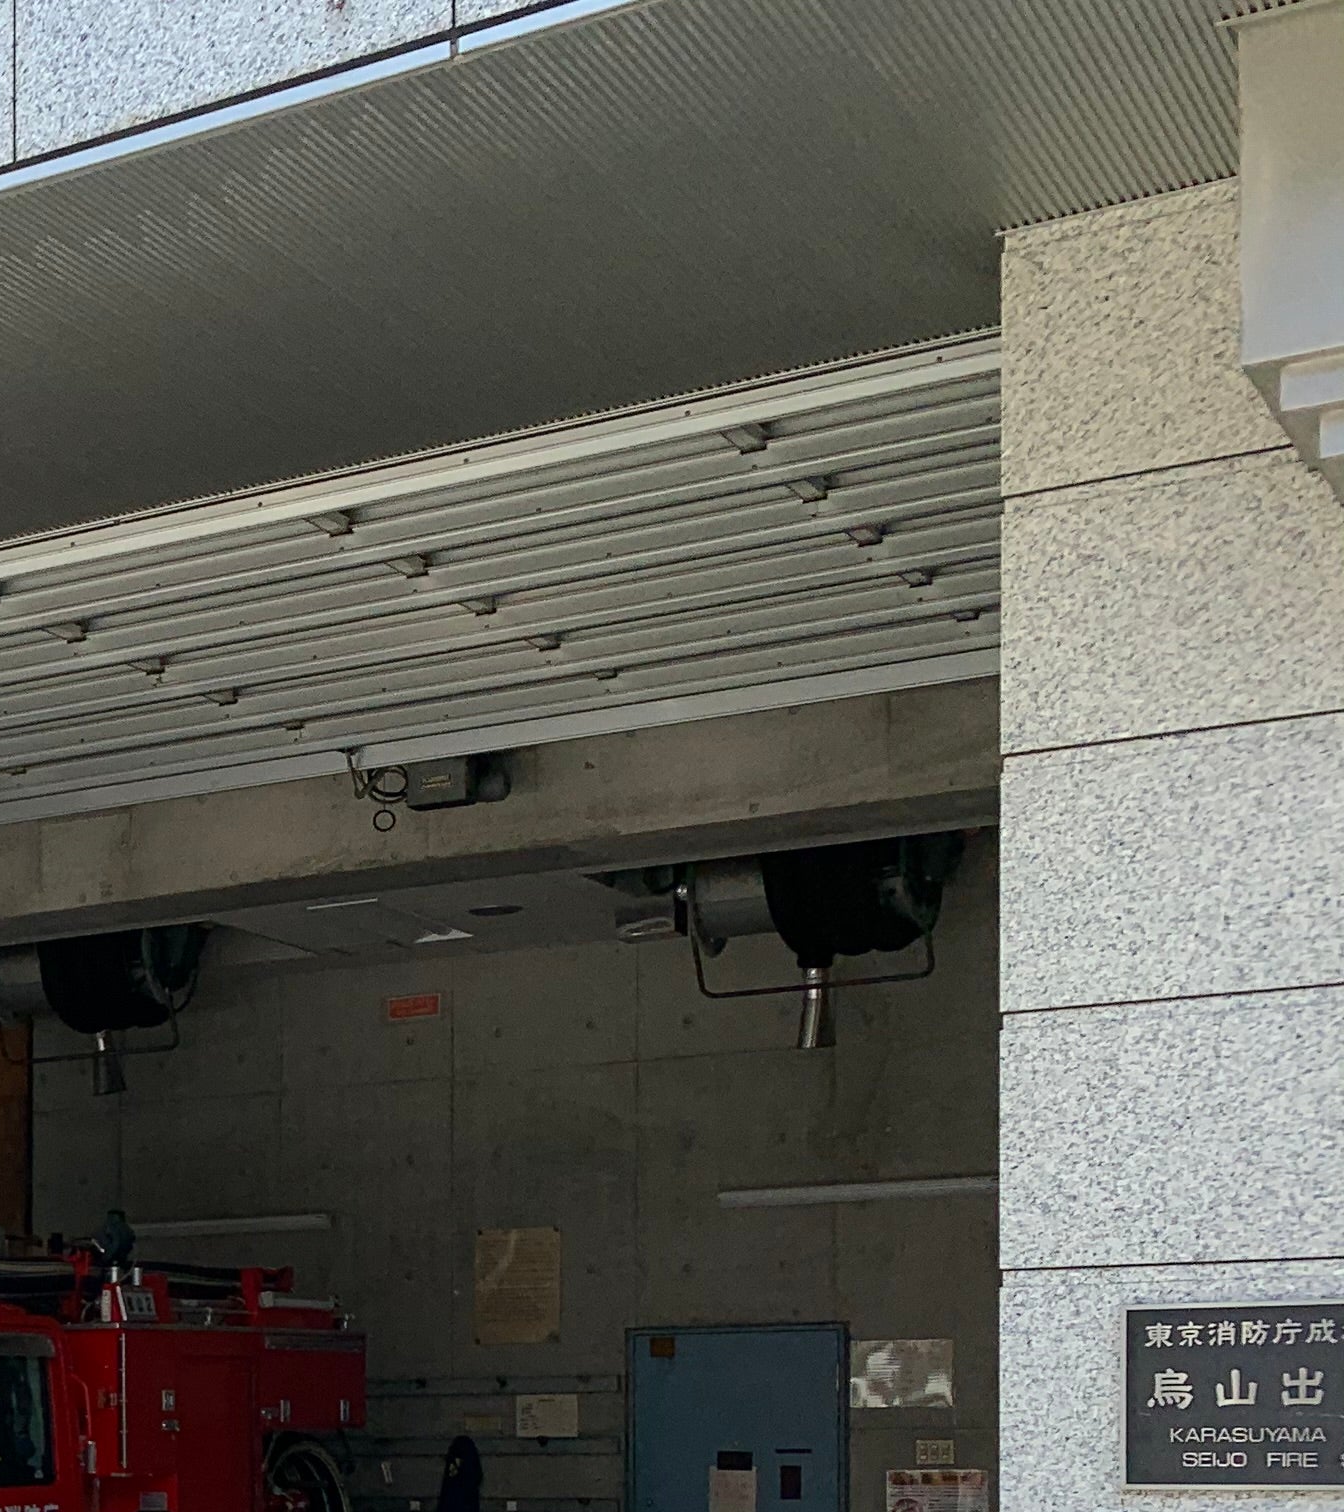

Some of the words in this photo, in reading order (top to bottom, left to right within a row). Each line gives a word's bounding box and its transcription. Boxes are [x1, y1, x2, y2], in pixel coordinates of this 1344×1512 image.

[1144, 1318, 1344, 1348] 東京消防庁成
[1169, 1426, 1327, 1443] KARASUYAMA
[1182, 1451, 1248, 1469] SEIJO
[1266, 1451, 1319, 1469] FIRE
